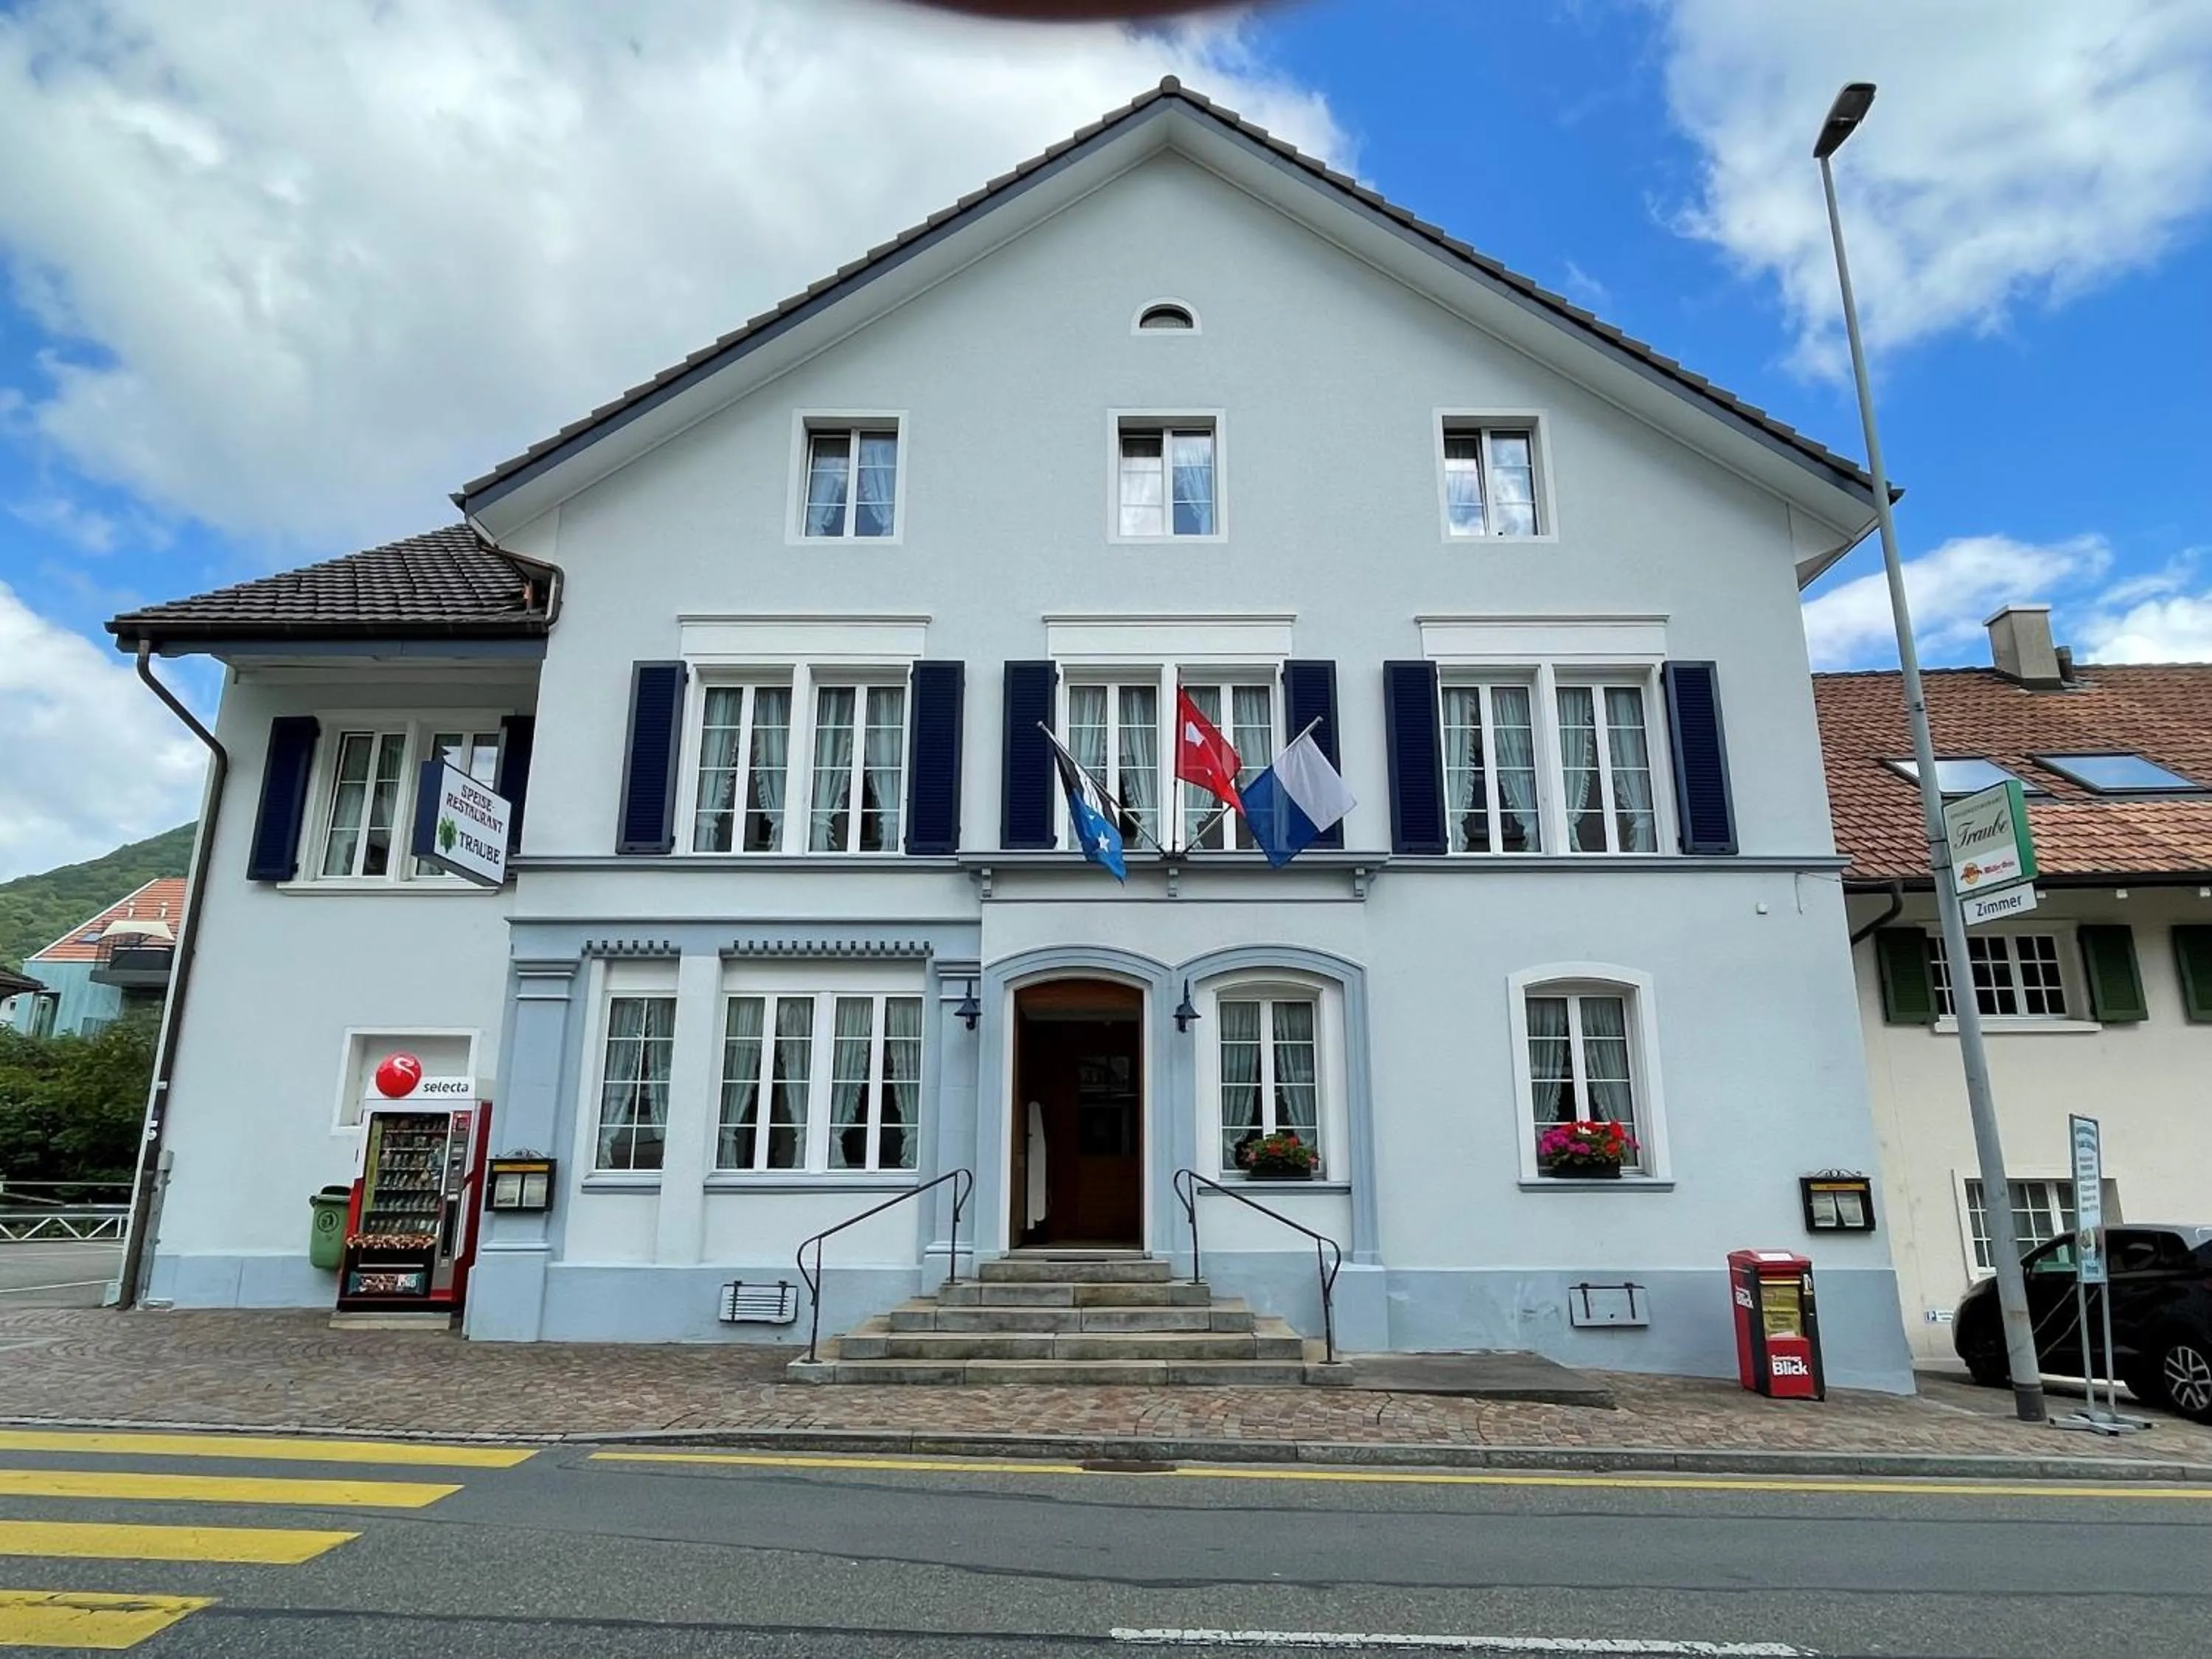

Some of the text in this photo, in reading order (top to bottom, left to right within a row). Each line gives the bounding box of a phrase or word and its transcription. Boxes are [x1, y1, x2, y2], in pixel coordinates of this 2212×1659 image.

[447, 793, 504, 834] RESTAURANT
[1954, 809, 2009, 849] Traube
[459, 831, 501, 865] TRAUBE
[1975, 894, 2023, 917] Zimmer
[423, 1082, 469, 1093] selecta
[1772, 1360, 1809, 1375] Blick
